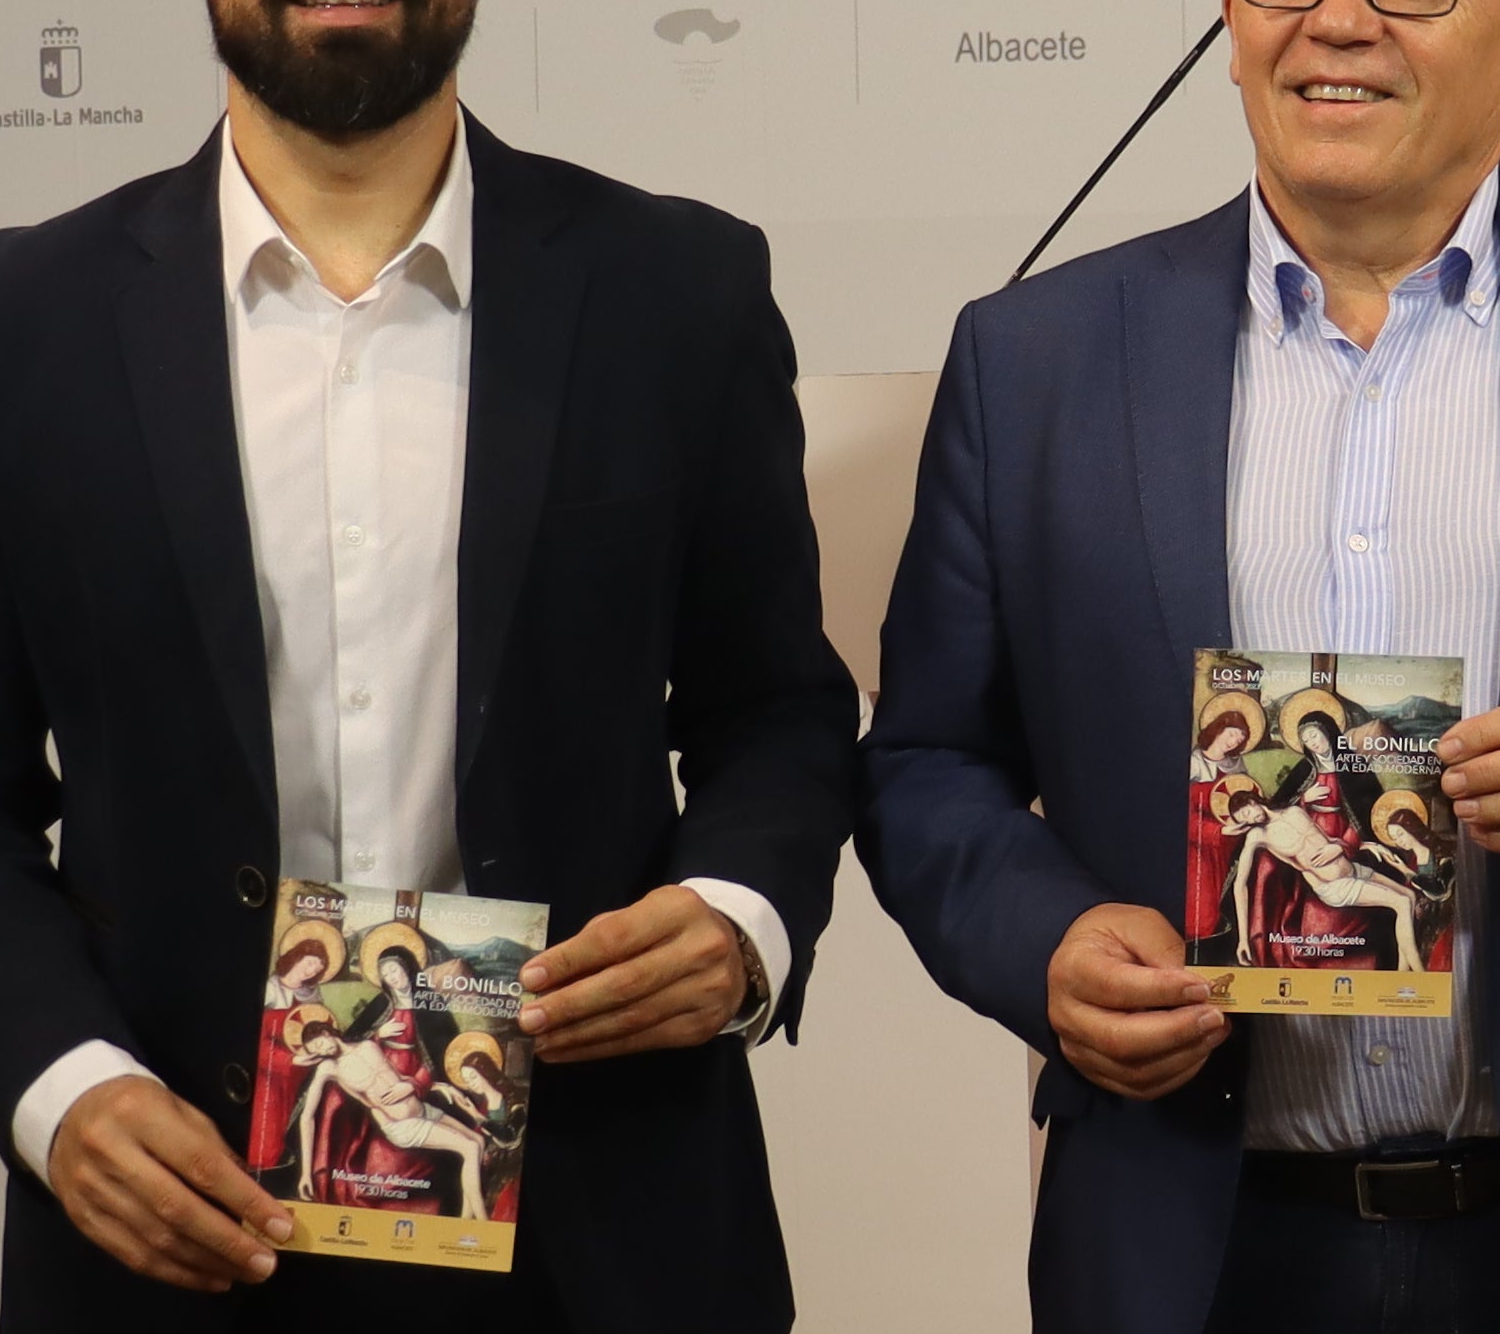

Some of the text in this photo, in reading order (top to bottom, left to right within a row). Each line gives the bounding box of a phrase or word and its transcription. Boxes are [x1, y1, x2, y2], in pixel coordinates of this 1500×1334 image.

[954, 29, 1088, 65] Albacete
[79, 105, 144, 127] Mancha
[1212, 668, 1242, 682] LOS
[1312, 671, 1332, 684] EN
[1355, 673, 1406, 688] MUSEO
[1337, 735, 1357, 750] EL
[1335, 753, 1442, 766] ARTE Y SOCIEDAD EN
[1335, 763, 1442, 775] LA EDAD MODERNA
[295, 894, 326, 911] LOS
[396, 905, 418, 919] EN
[1268, 932, 1366, 946] Museo de Albacete
[1317, 945, 1345, 958] horas
[415, 971, 523, 997] EL BONILLO
[505, 999, 521, 1009] EN
[332, 1169, 432, 1190] Museo de Albacete
[380, 1185, 409, 1200] horas
